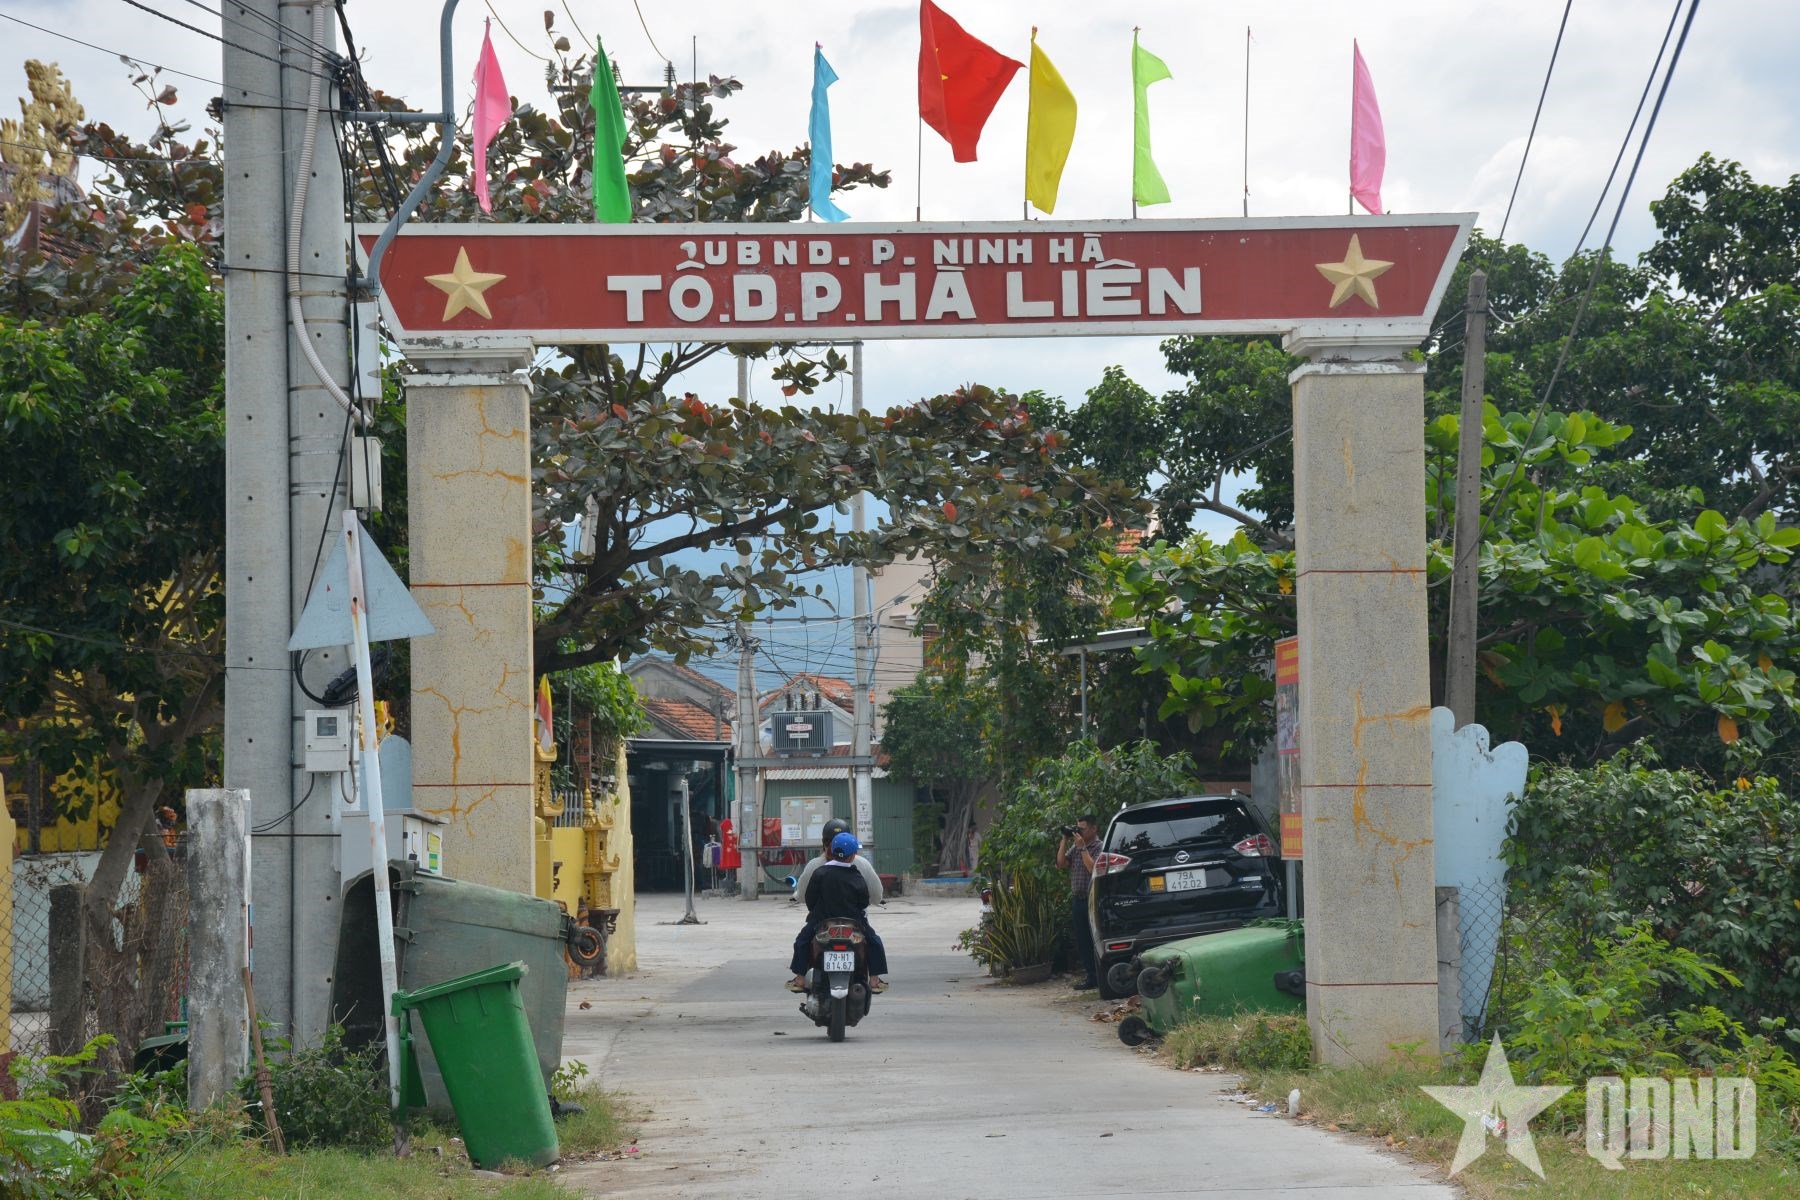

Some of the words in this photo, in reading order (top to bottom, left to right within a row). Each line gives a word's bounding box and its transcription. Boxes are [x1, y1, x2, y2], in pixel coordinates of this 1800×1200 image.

[704, 239, 850, 266] UBND.
[872, 238, 916, 266] P.
[933, 237, 1033, 265] NINH
[1049, 232, 1105, 263] HÀ
[1006, 257, 1202, 318] LIÊN
[1176, 871, 1194, 881] 79A
[1171, 879, 1203, 890] 412.02
[829, 953, 849, 962] 79-H1
